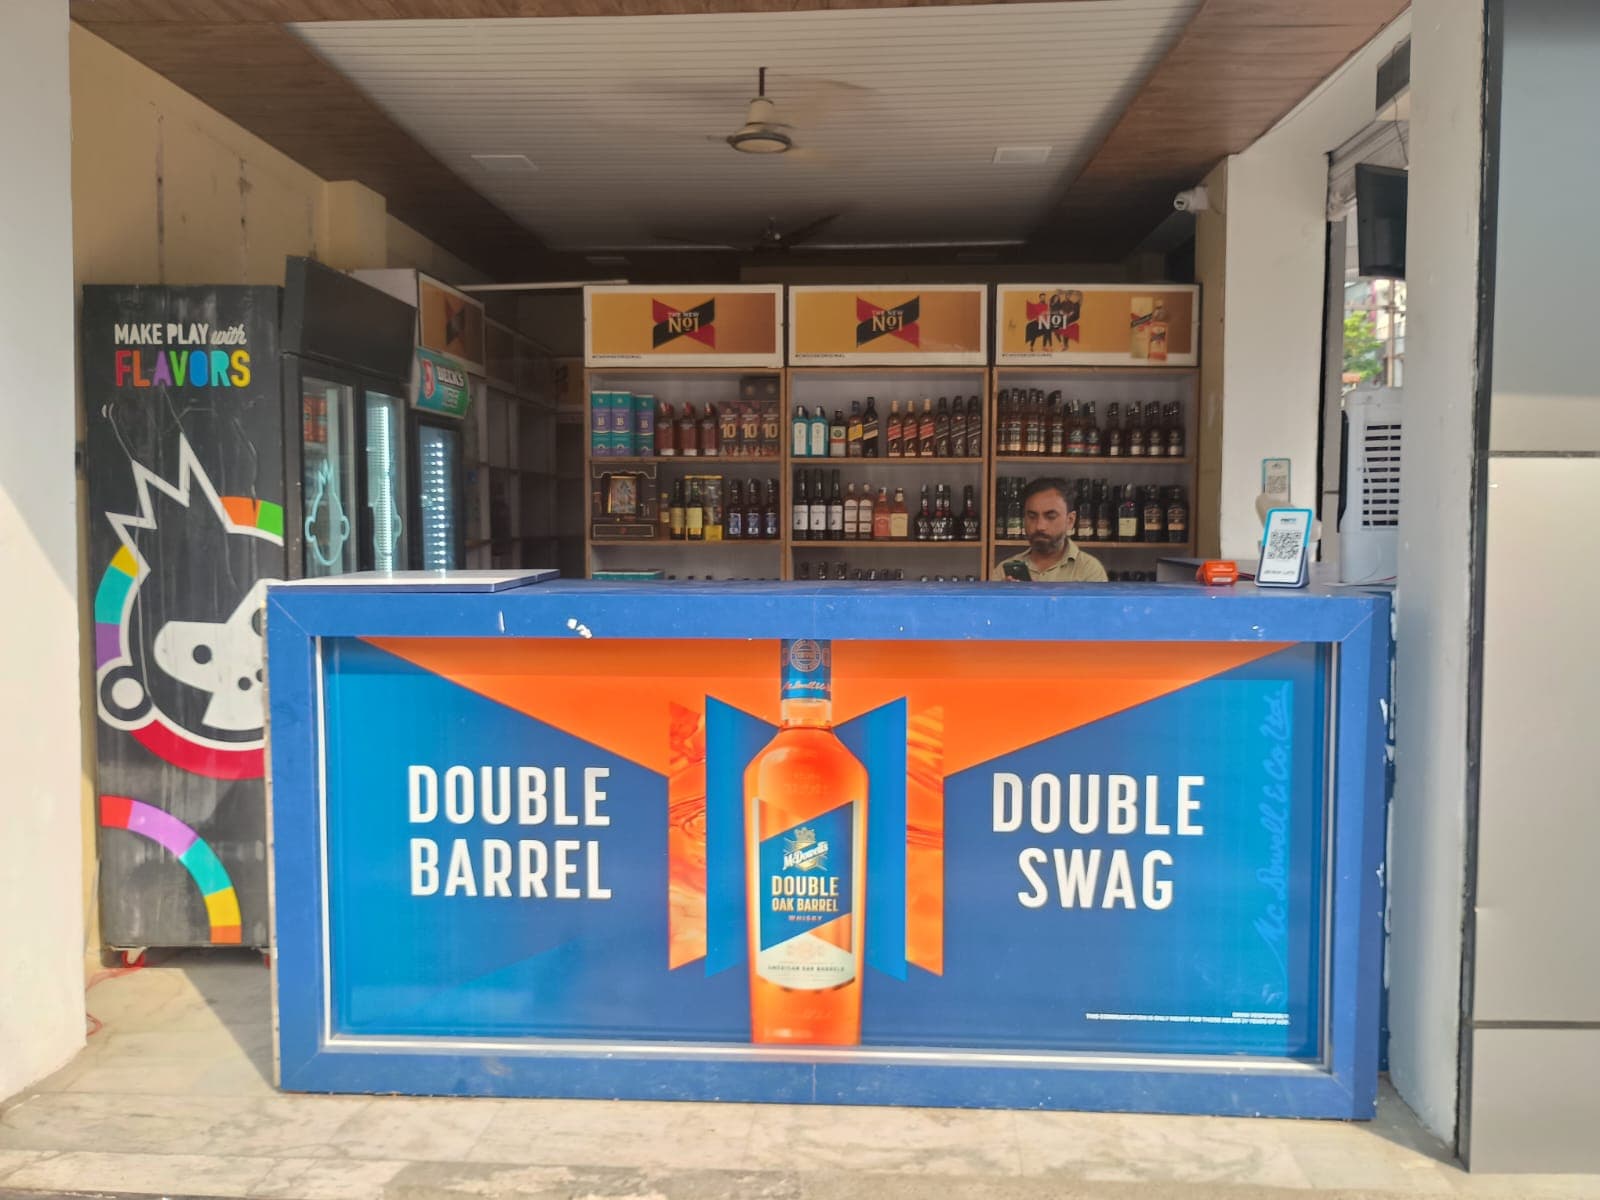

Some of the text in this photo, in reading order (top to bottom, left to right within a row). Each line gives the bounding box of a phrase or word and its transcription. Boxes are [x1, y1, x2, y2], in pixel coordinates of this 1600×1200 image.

[114, 323, 248, 345] MAKE PLAY with
[115, 349, 251, 387] FLAVORS
[720, 423, 737, 439] 10
[741, 423, 758, 439] 10
[762, 423, 779, 439] 10
[408, 765, 611, 826] DOUBLE
[992, 772, 1205, 836] DOUBLE
[410, 837, 612, 899] BARREL
[1017, 847, 1174, 911] SWAG
[771, 875, 840, 897] DOUBLE
[771, 897, 839, 913] OAK BARREL
